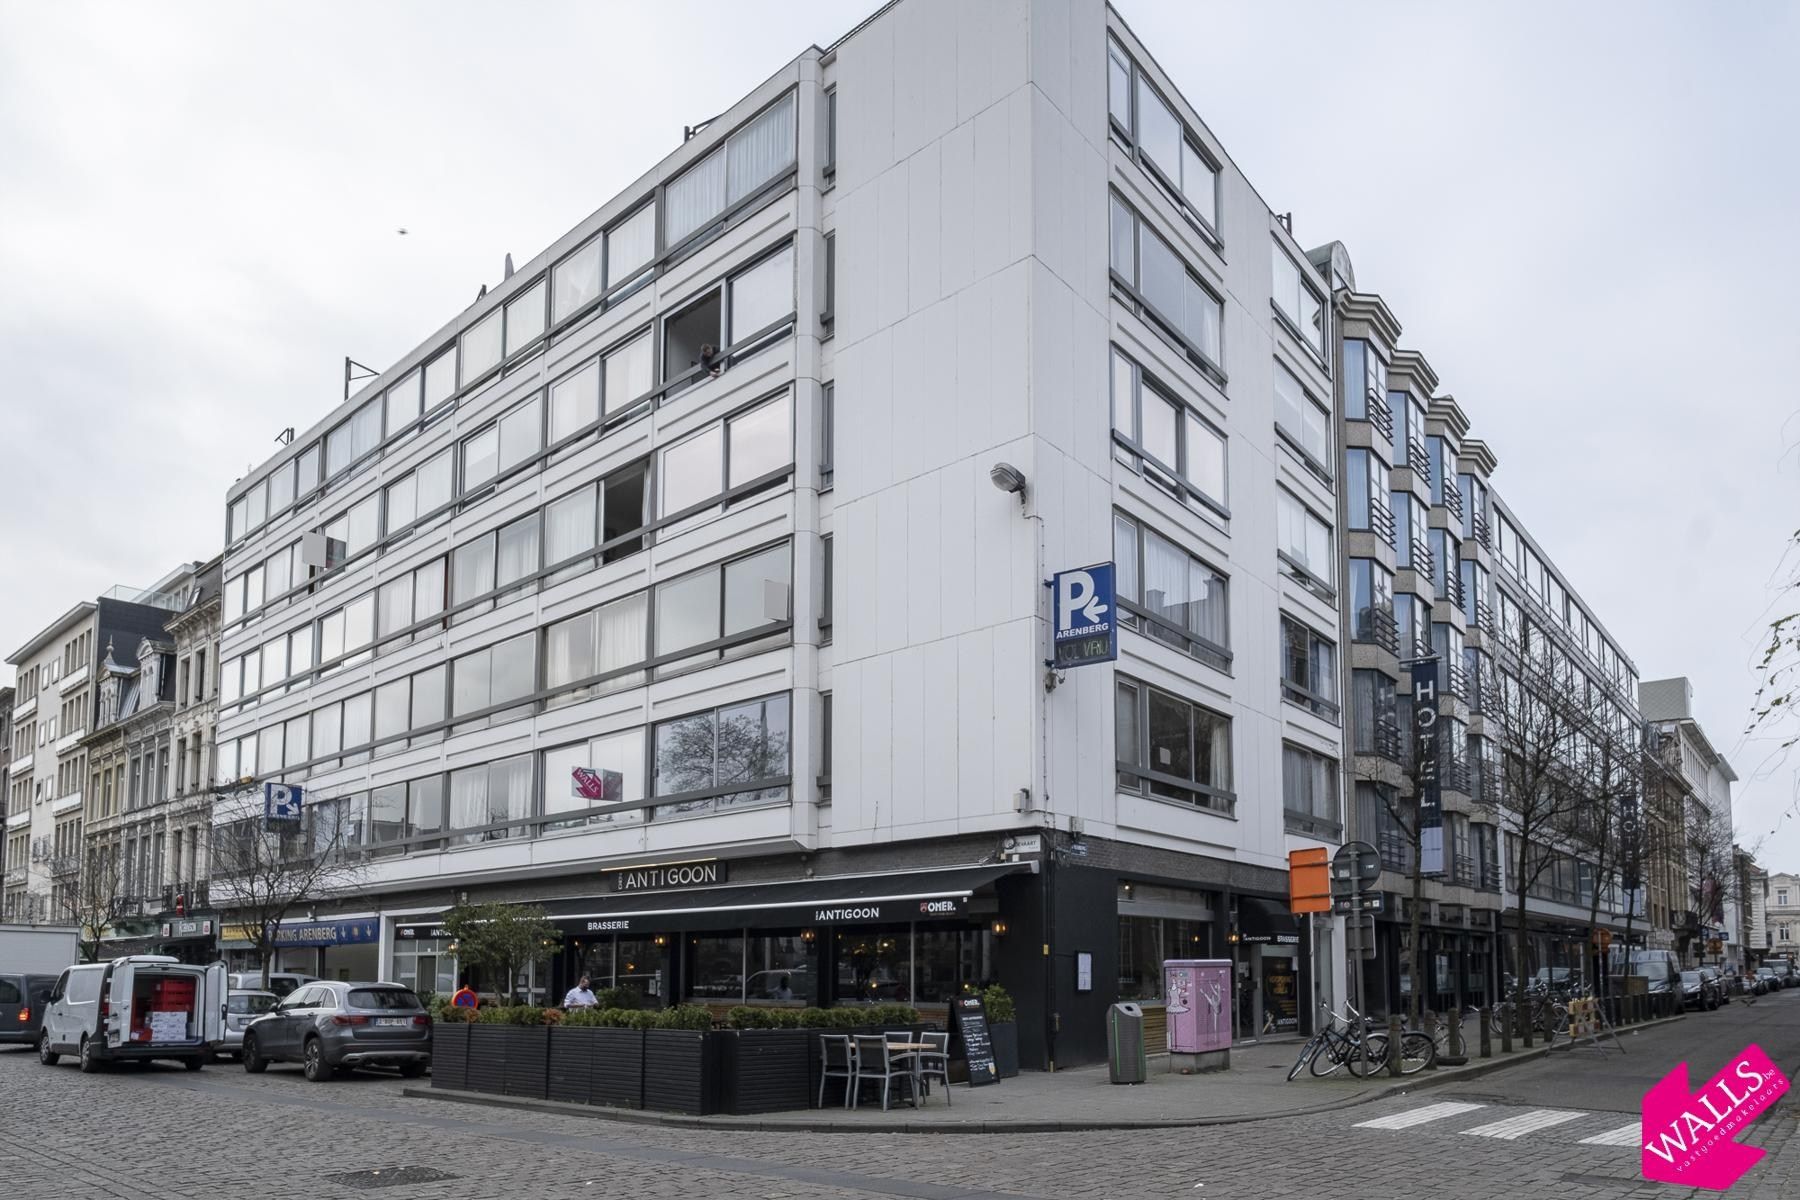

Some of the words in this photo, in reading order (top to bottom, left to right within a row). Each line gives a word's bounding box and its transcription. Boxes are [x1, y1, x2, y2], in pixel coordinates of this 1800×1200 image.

[1059, 570, 1095, 630] P
[1056, 623, 1109, 639] ARENBERG
[1416, 680, 1436, 808] HOTEL
[270, 784, 293, 815] P
[625, 864, 717, 889] ANTIGOON
[819, 907, 880, 920] ANTIGOON
[268, 929, 298, 941] PRKING
[299, 926, 336, 941] ARENBERG
[587, 920, 629, 930] BRASSERIE
